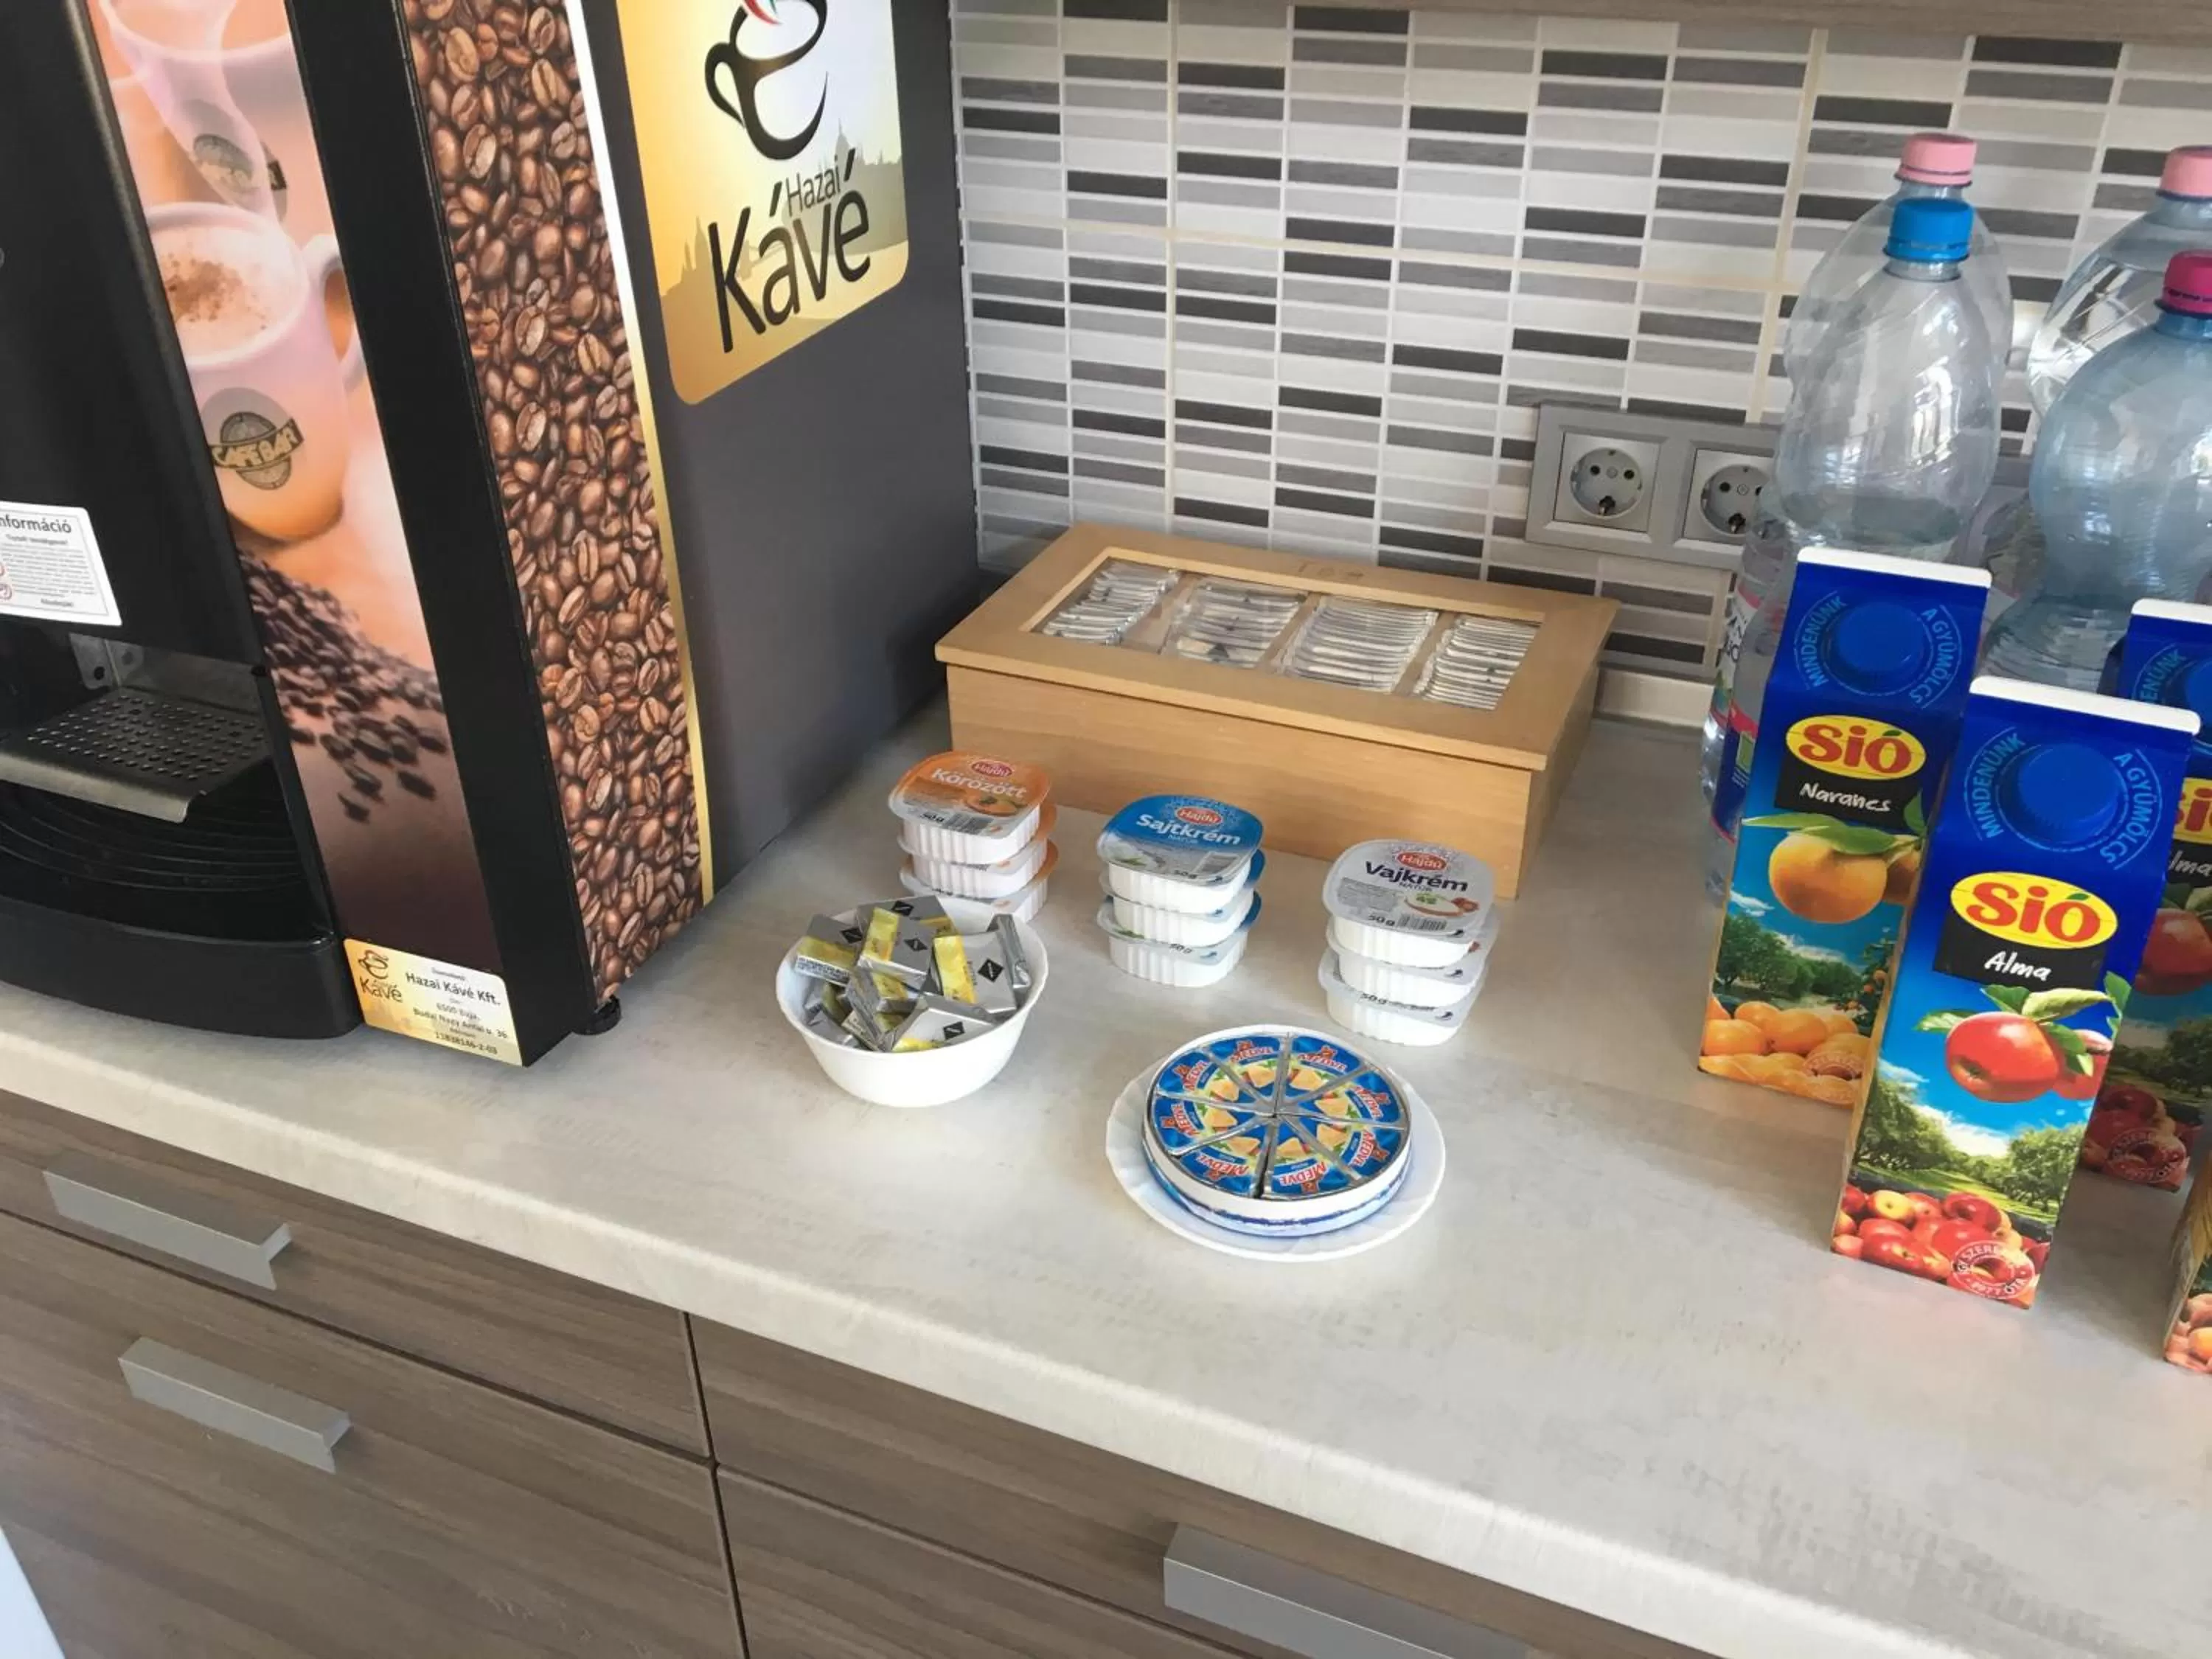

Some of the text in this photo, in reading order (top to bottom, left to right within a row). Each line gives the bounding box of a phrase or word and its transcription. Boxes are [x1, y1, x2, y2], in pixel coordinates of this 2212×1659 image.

[785, 155, 842, 214] Hazai
[708, 149, 871, 354] Kávé
[0, 513, 72, 534] nformáció
[1920, 608, 1939, 623] A
[1800, 594, 1848, 689] MINDENÜNK
[1907, 620, 1958, 705] GYÜMÖLCS
[2139, 647, 2188, 700] ENÜNK
[1798, 723, 1913, 774] Sió
[2112, 751, 2134, 768] A
[931, 767, 1028, 799] Körözött
[1799, 782, 1892, 813] Narancs
[1972, 731, 2026, 841] MINDENÜNK
[1135, 813, 1242, 846] Sajtkrém
[1178, 808, 1219, 825] Hajdú
[2098, 768, 2160, 864] GYÜMÖLCS
[1364, 860, 1470, 892] Vajkrém
[1401, 853, 1444, 870] Hajdú
[2168, 849, 2212, 877] lma
[1965, 880, 2101, 943] Sió
[1983, 949, 2053, 982] Alma
[359, 976, 403, 1004] Kávé
[405, 972, 441, 990] Hazai
[442, 981, 476, 999] Kávé
[477, 990, 501, 1006] Kft.
[1279, 1161, 1328, 1186] MEDVE
